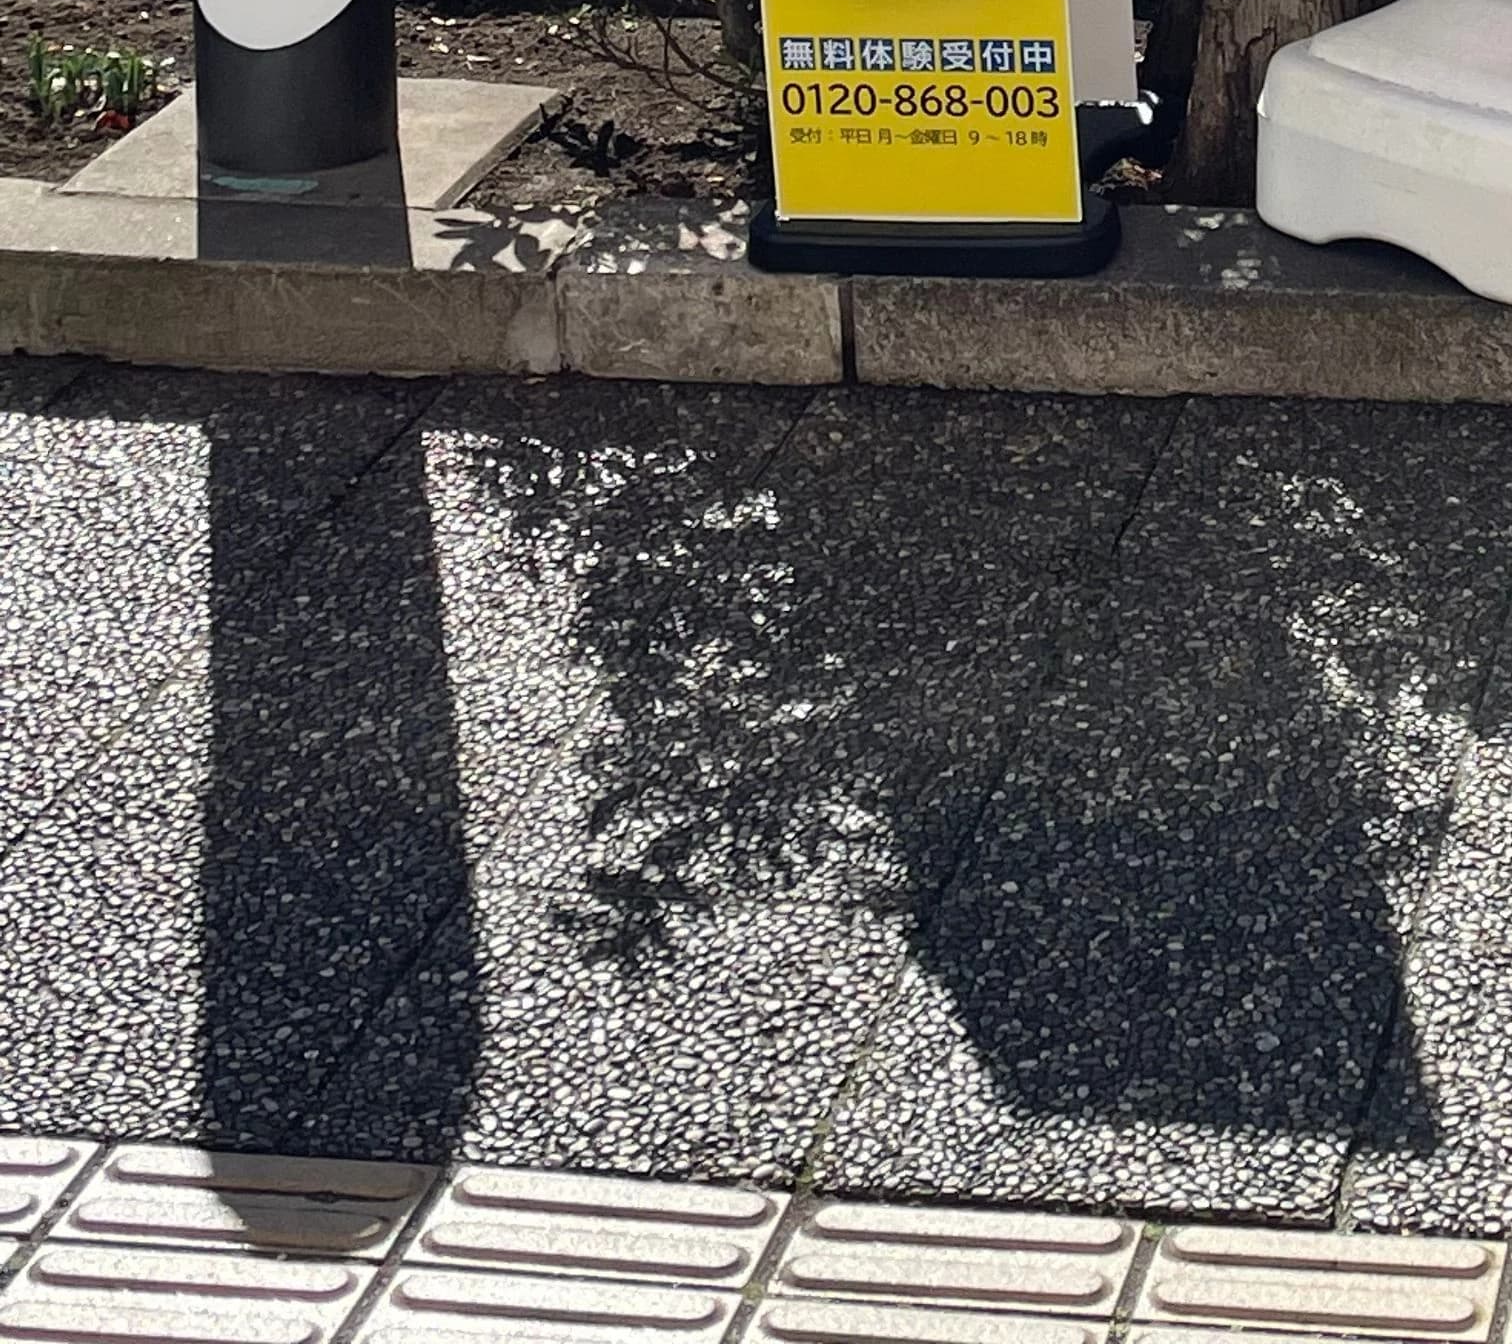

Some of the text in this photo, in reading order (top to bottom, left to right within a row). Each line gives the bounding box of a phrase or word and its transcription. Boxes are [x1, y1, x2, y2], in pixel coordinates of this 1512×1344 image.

[782, 39, 1054, 72] 無料体験受付中
[782, 83, 1060, 118] 0120-868-003
